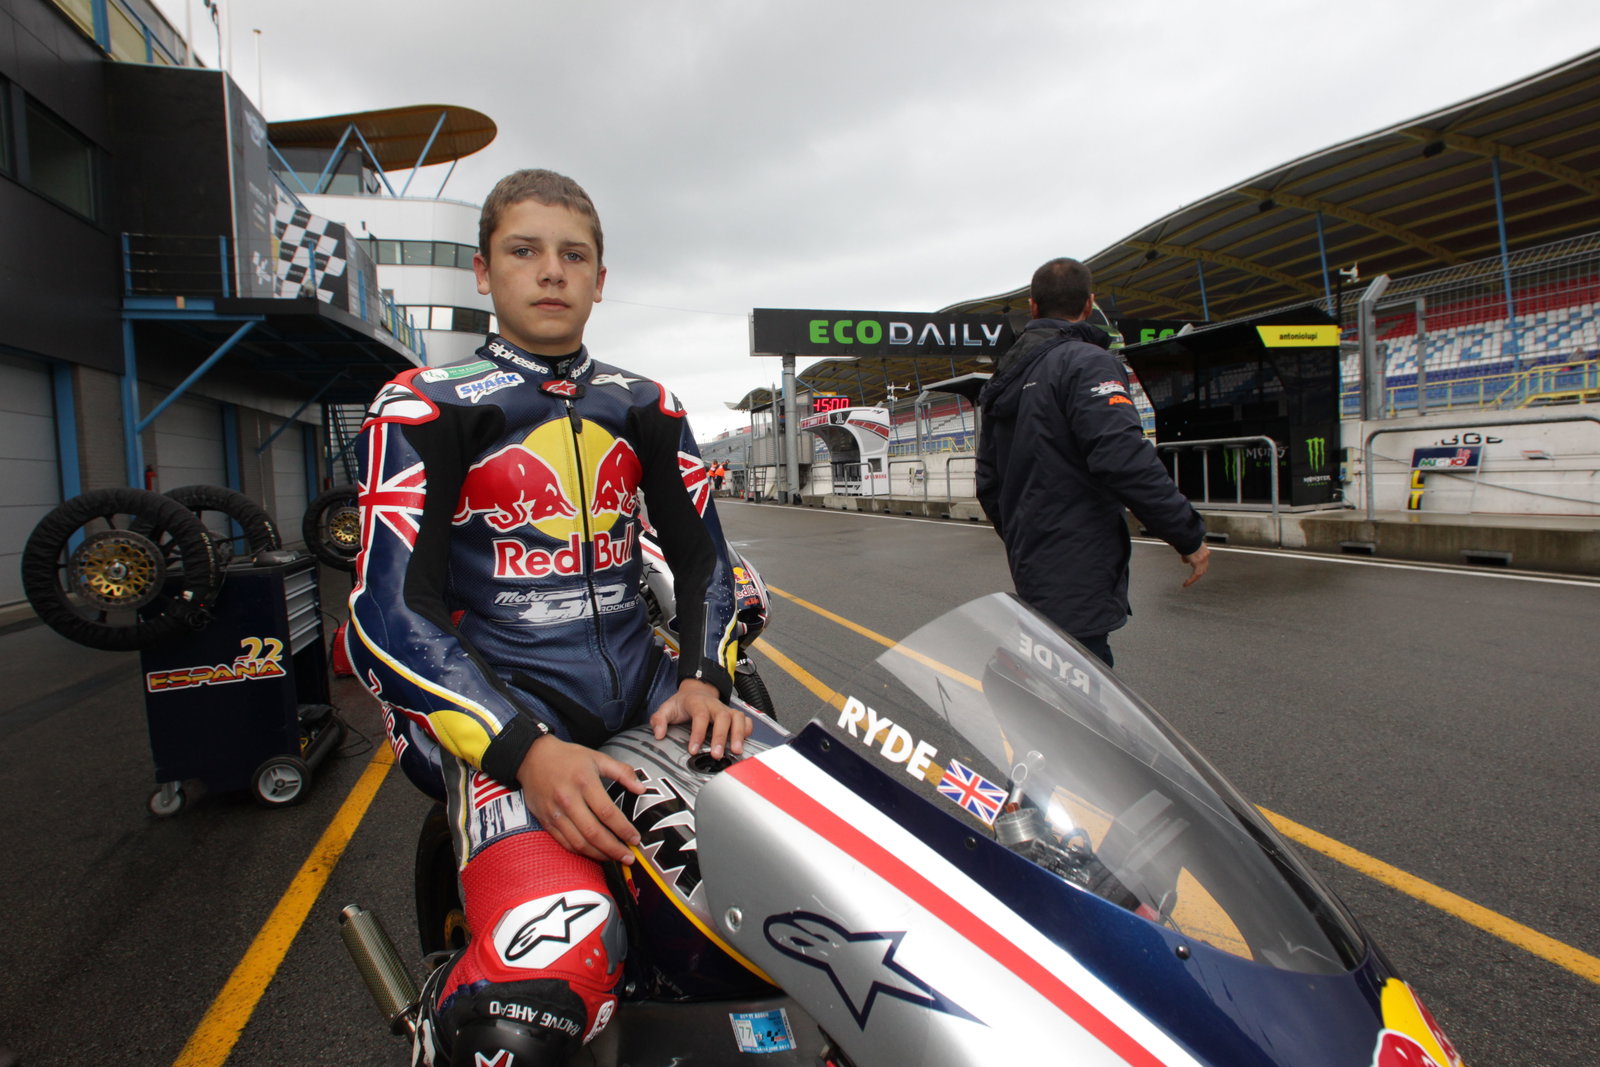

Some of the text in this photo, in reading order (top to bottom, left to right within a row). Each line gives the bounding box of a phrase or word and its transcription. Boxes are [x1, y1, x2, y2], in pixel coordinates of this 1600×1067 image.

[1279, 332, 1318, 341] antoniolupi
[489, 342, 549, 375] alpinestars
[459, 373, 520, 396] SHARK
[493, 522, 635, 578] Red Bull
[600, 601, 636, 612] ROOKIES
[240, 636, 284, 666] 22
[147, 655, 286, 692] ESPAÑA
[837, 695, 938, 781] RYDE
[489, 1000, 582, 1037] RACING AHEAD
